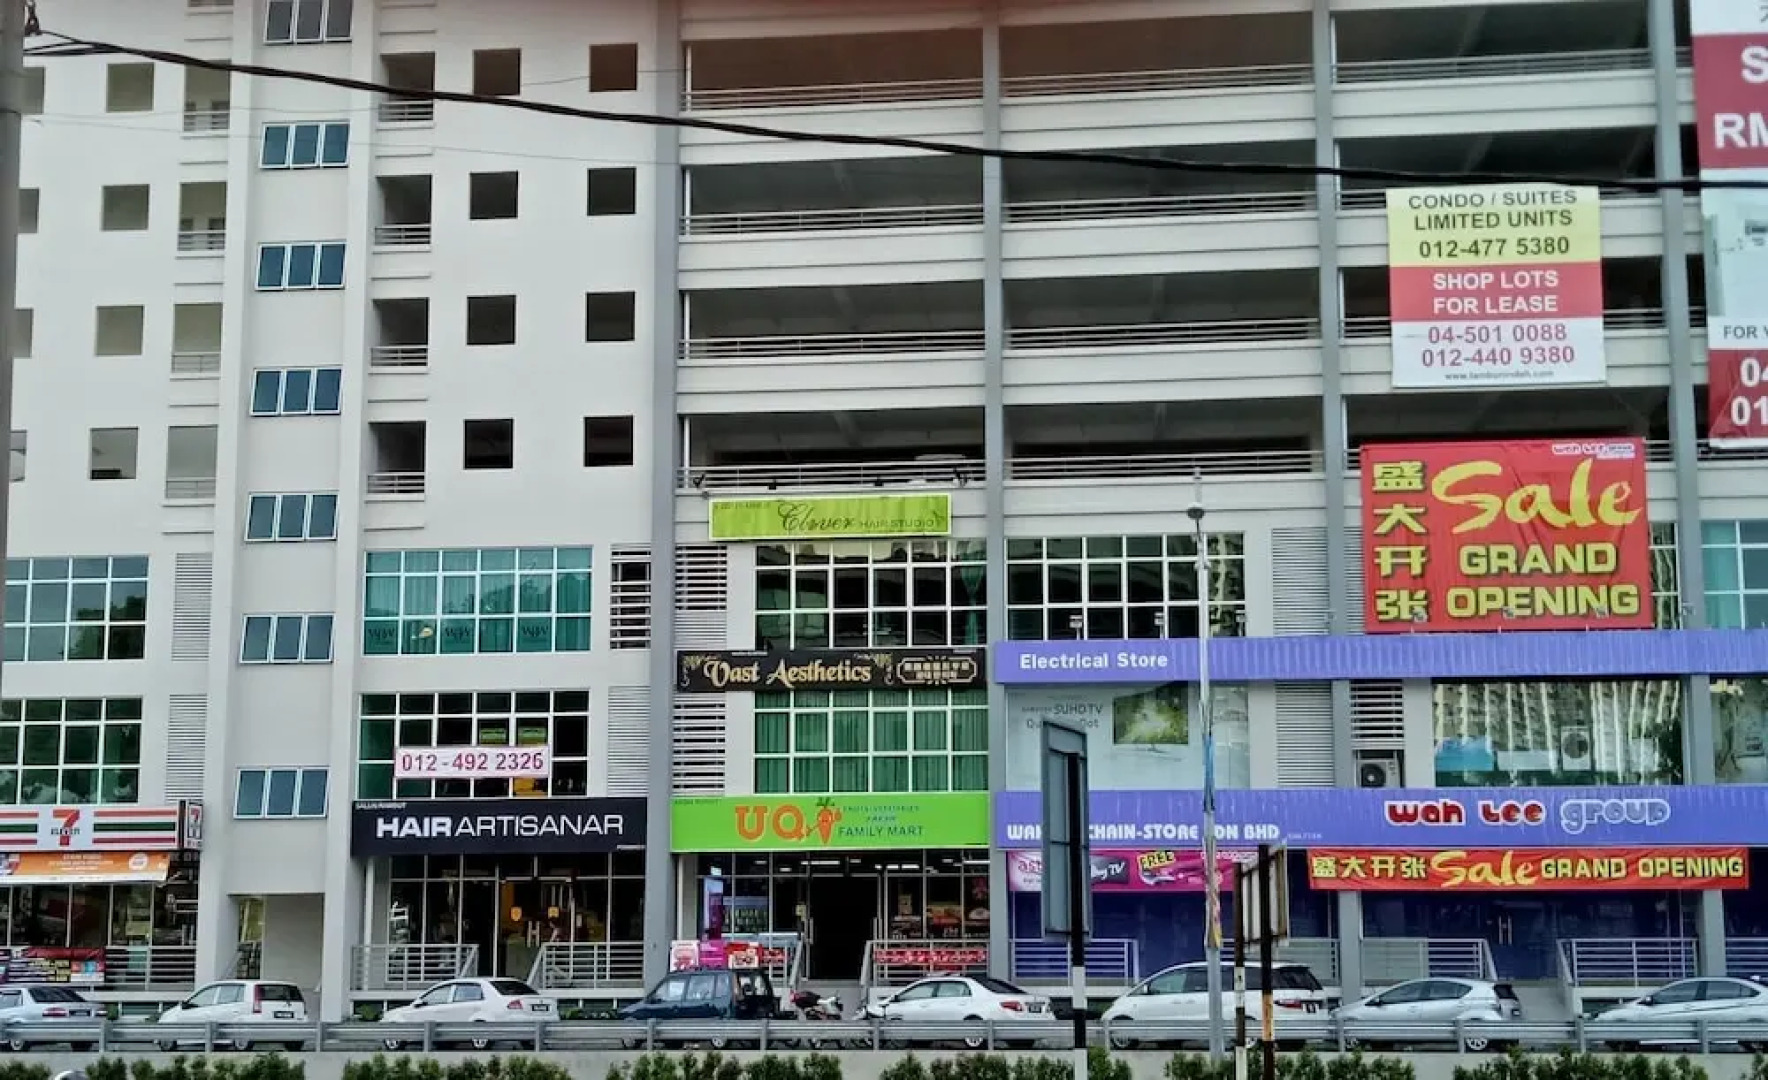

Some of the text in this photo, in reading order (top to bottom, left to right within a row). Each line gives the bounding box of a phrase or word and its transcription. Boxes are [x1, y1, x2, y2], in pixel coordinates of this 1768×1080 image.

[1408, 193, 1484, 209] CONDO
[1503, 190, 1577, 206] SUITES
[1415, 209, 1573, 230] LIMITED UNITS
[1419, 236, 1570, 258] 012-477 5380
[1433, 270, 1558, 290] SHOP LOTS
[1433, 295, 1558, 314] FOR LEASE
[1428, 323, 1567, 344] 04-501 0088
[1723, 325, 1757, 339] FOR
[1422, 346, 1574, 367] 012-440 9380
[1431, 458, 1642, 534] Sale
[891, 519, 934, 528] STUDIO
[1372, 461, 1427, 622] 盛大开张
[1459, 542, 1617, 576] GRAND
[1446, 584, 1640, 618] OPENING
[1019, 653, 1168, 669] Electrical Store
[703, 659, 760, 688] Vast
[766, 659, 871, 688] Aesthetics
[495, 752, 543, 771] 2326
[376, 814, 624, 838] HAIR ARTISANAR
[1561, 799, 1671, 834] group
[838, 825, 923, 837] FAMILY MART
[1211, 824, 1238, 840] DN
[1245, 823, 1280, 840] BHD
[1108, 861, 1126, 875] TV
[1139, 851, 1175, 869] FREE
[1312, 851, 1744, 888] 盛大开张 Sale GRAND OPENING
